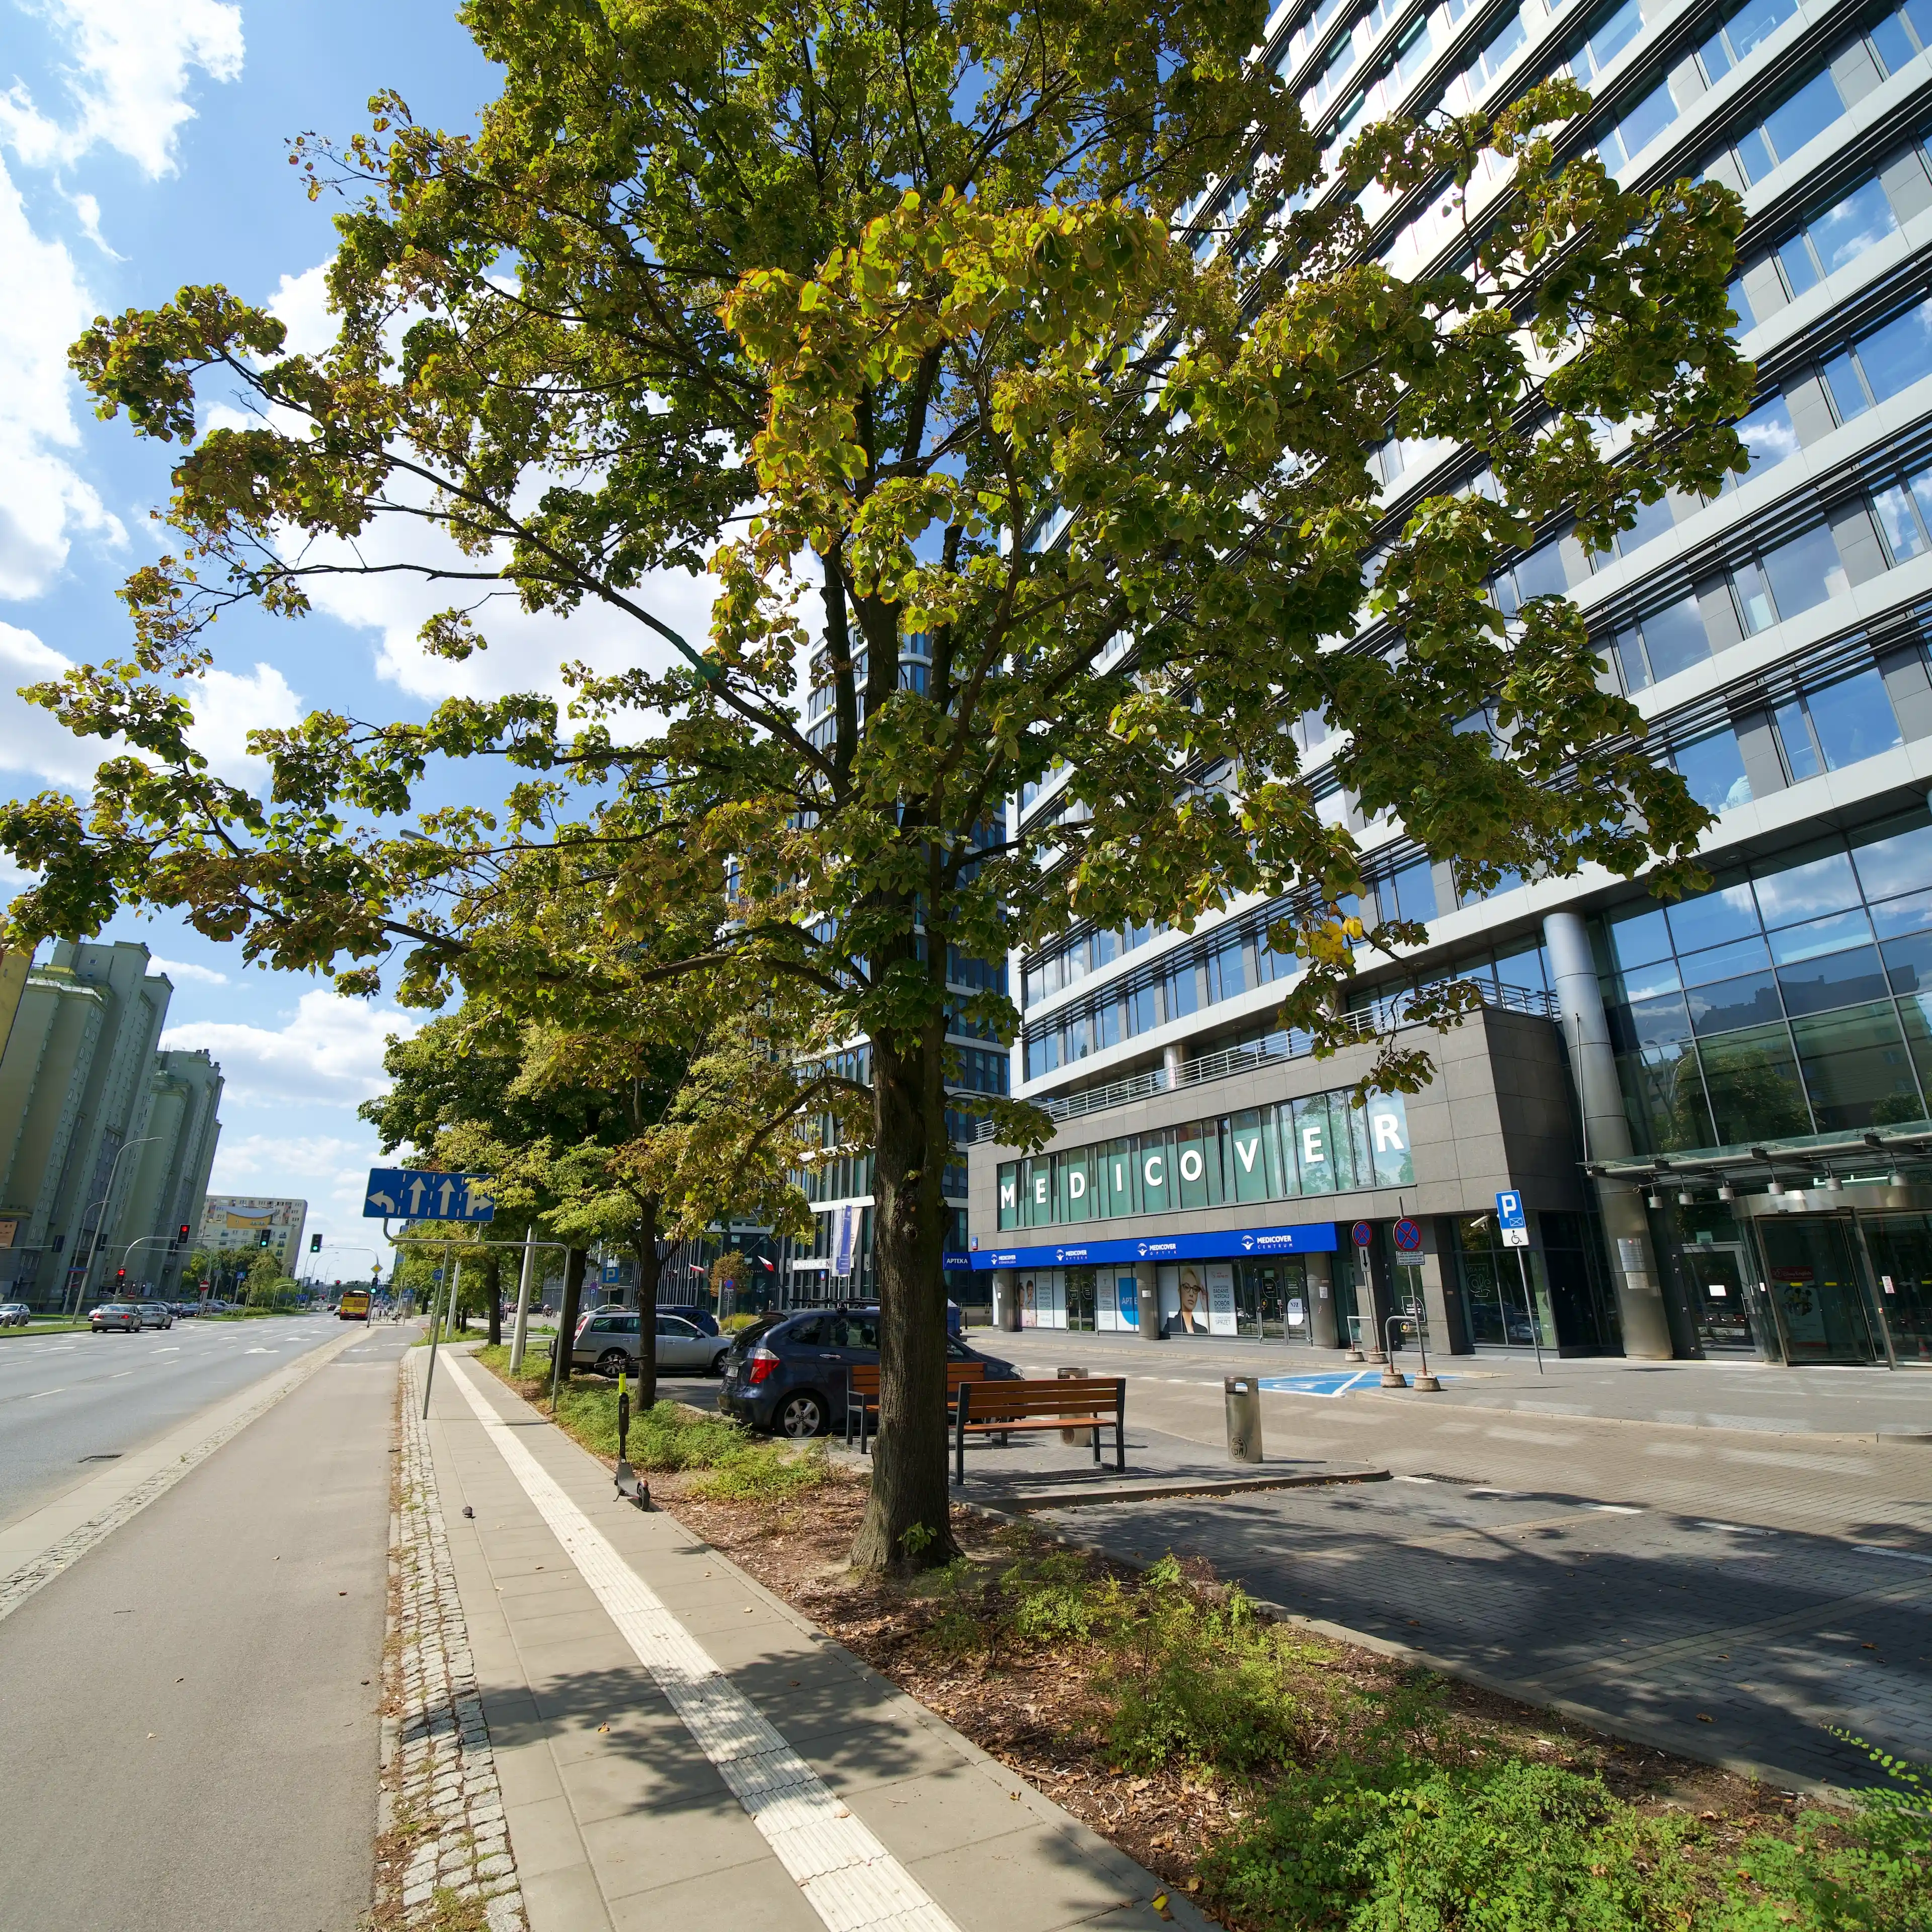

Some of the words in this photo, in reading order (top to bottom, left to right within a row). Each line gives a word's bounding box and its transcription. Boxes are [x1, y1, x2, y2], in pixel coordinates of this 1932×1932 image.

[1000, 1113, 1405, 1210] MEDICOVER
[1501, 1194, 1517, 1218] P
[1257, 1235, 1292, 1244] MEDICOVER
[606, 1269, 615, 1281] P
